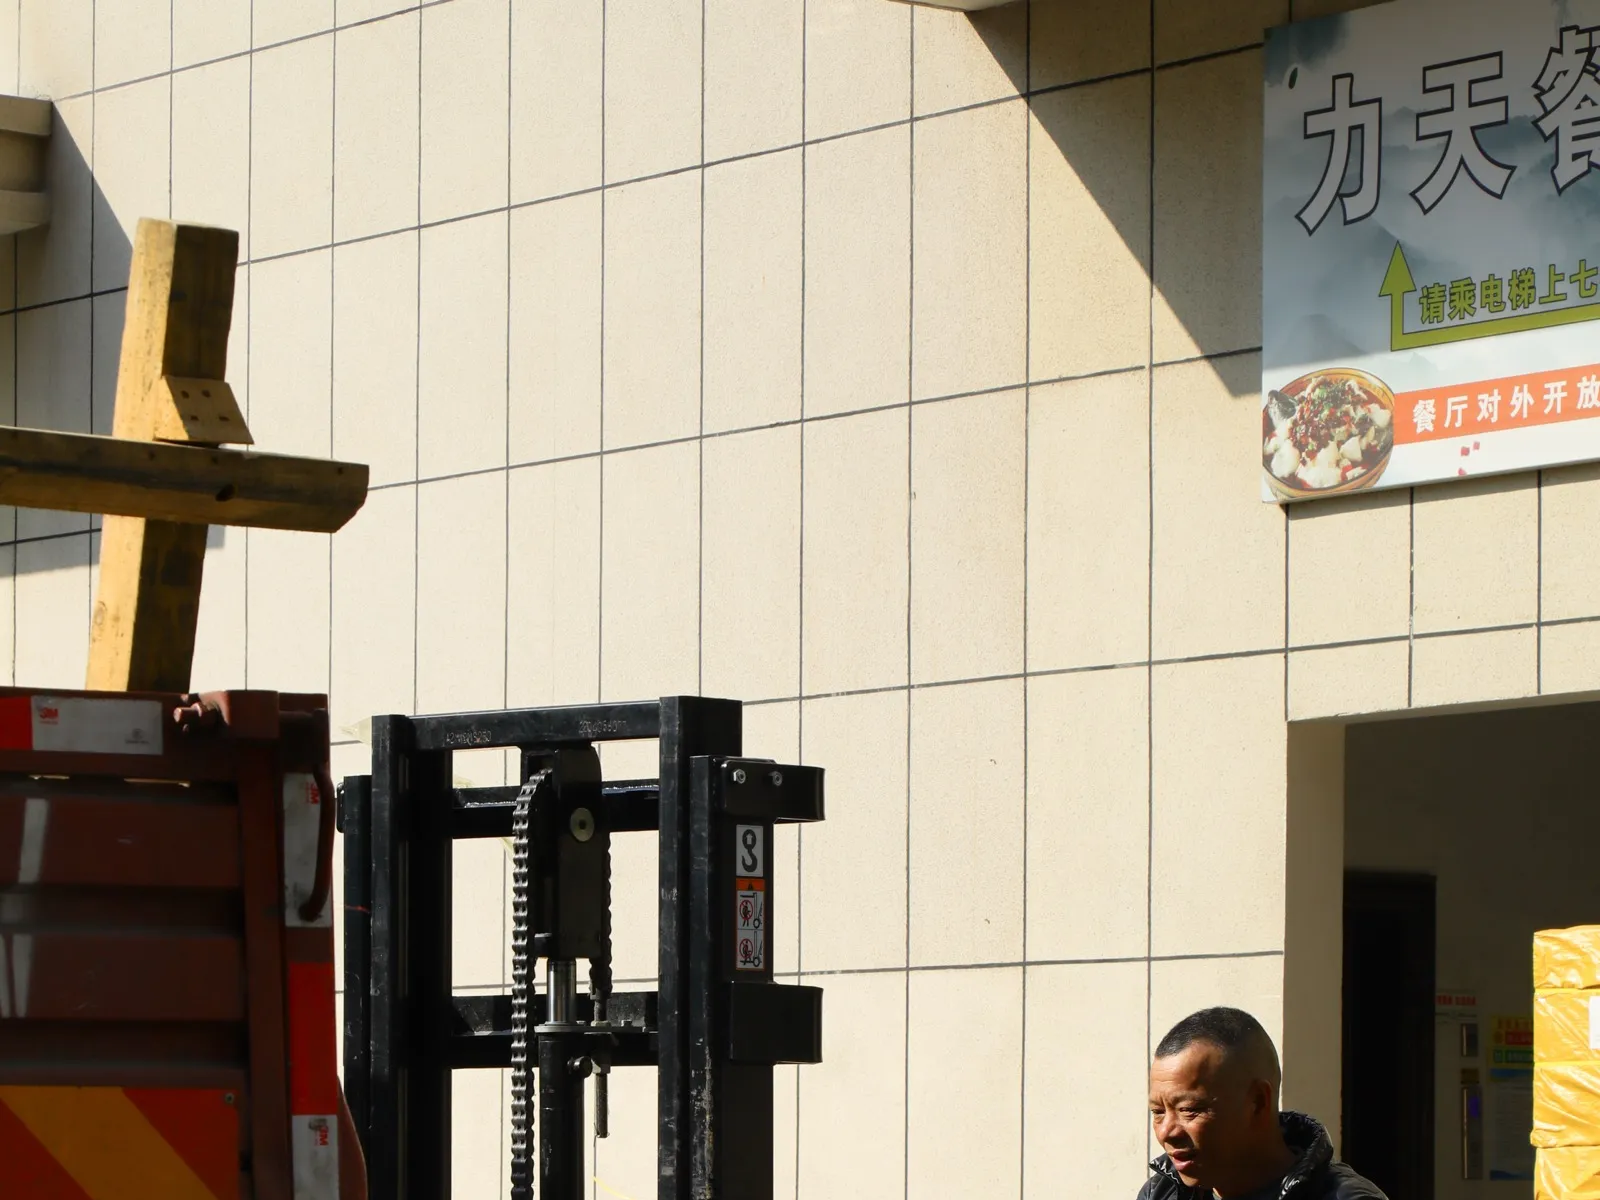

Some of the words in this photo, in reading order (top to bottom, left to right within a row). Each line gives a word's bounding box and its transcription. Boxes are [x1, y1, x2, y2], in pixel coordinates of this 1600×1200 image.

[1419, 259, 1598, 324] 请乘电梯上七
[1413, 375, 1600, 434] 餐厅对外开放
[39, 707, 58, 719] 3M
